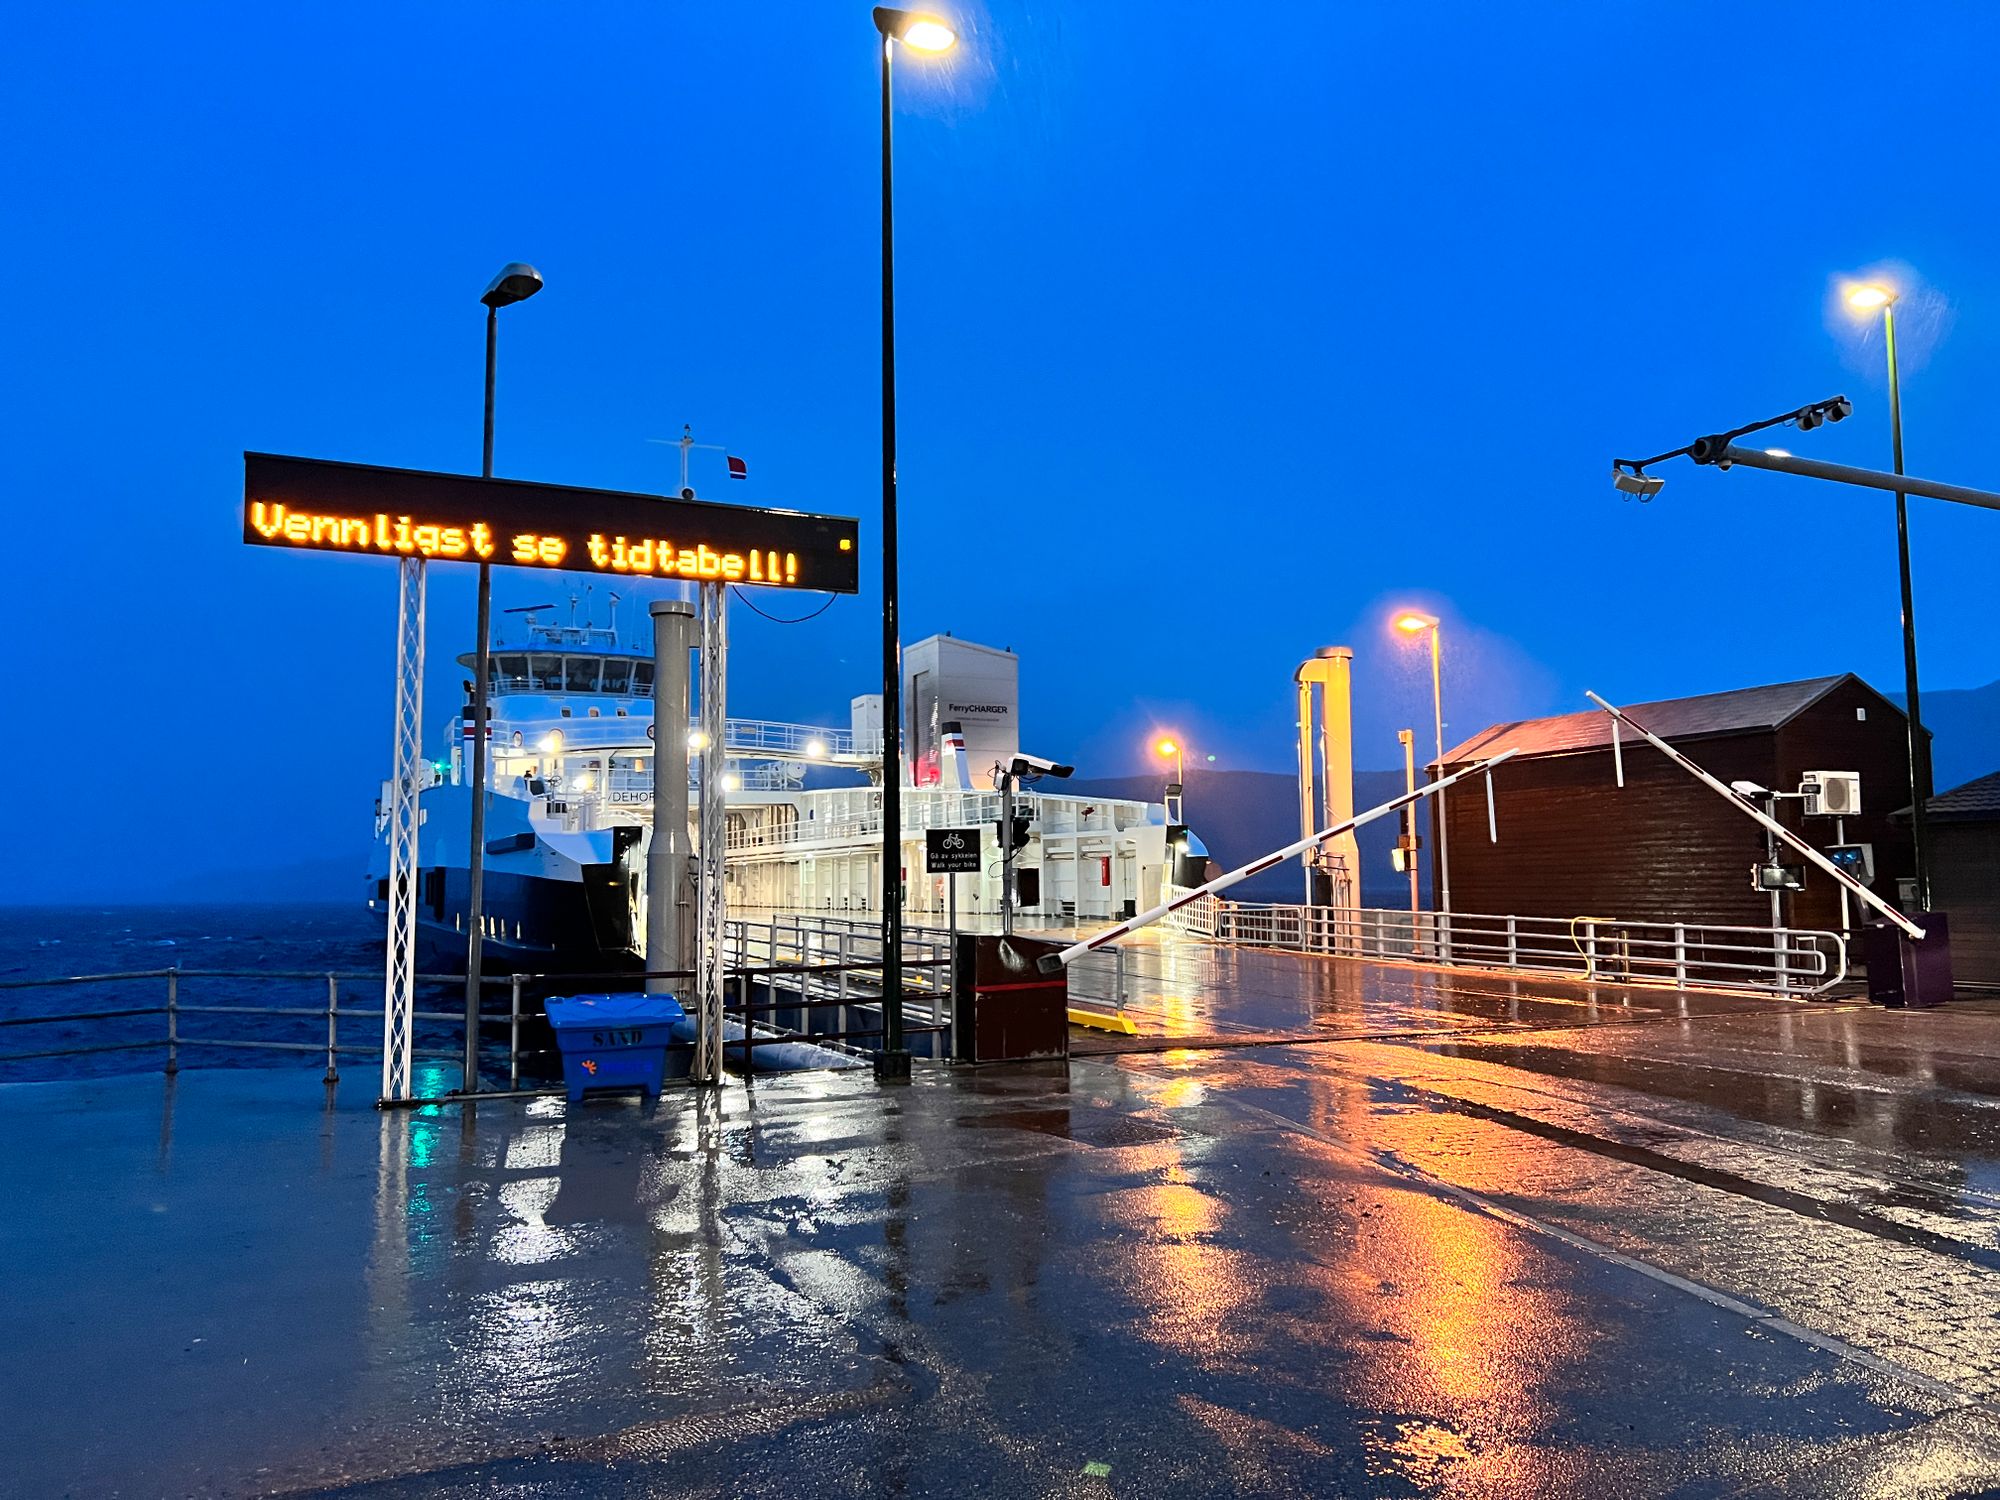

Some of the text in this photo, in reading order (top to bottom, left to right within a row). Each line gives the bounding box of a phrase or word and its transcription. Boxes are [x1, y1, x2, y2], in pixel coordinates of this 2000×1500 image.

[250, 501, 797, 585] Vennligst se tidtabell!
[949, 703, 1008, 714] FerryCHARGER
[592, 1030, 643, 1048] SAND
